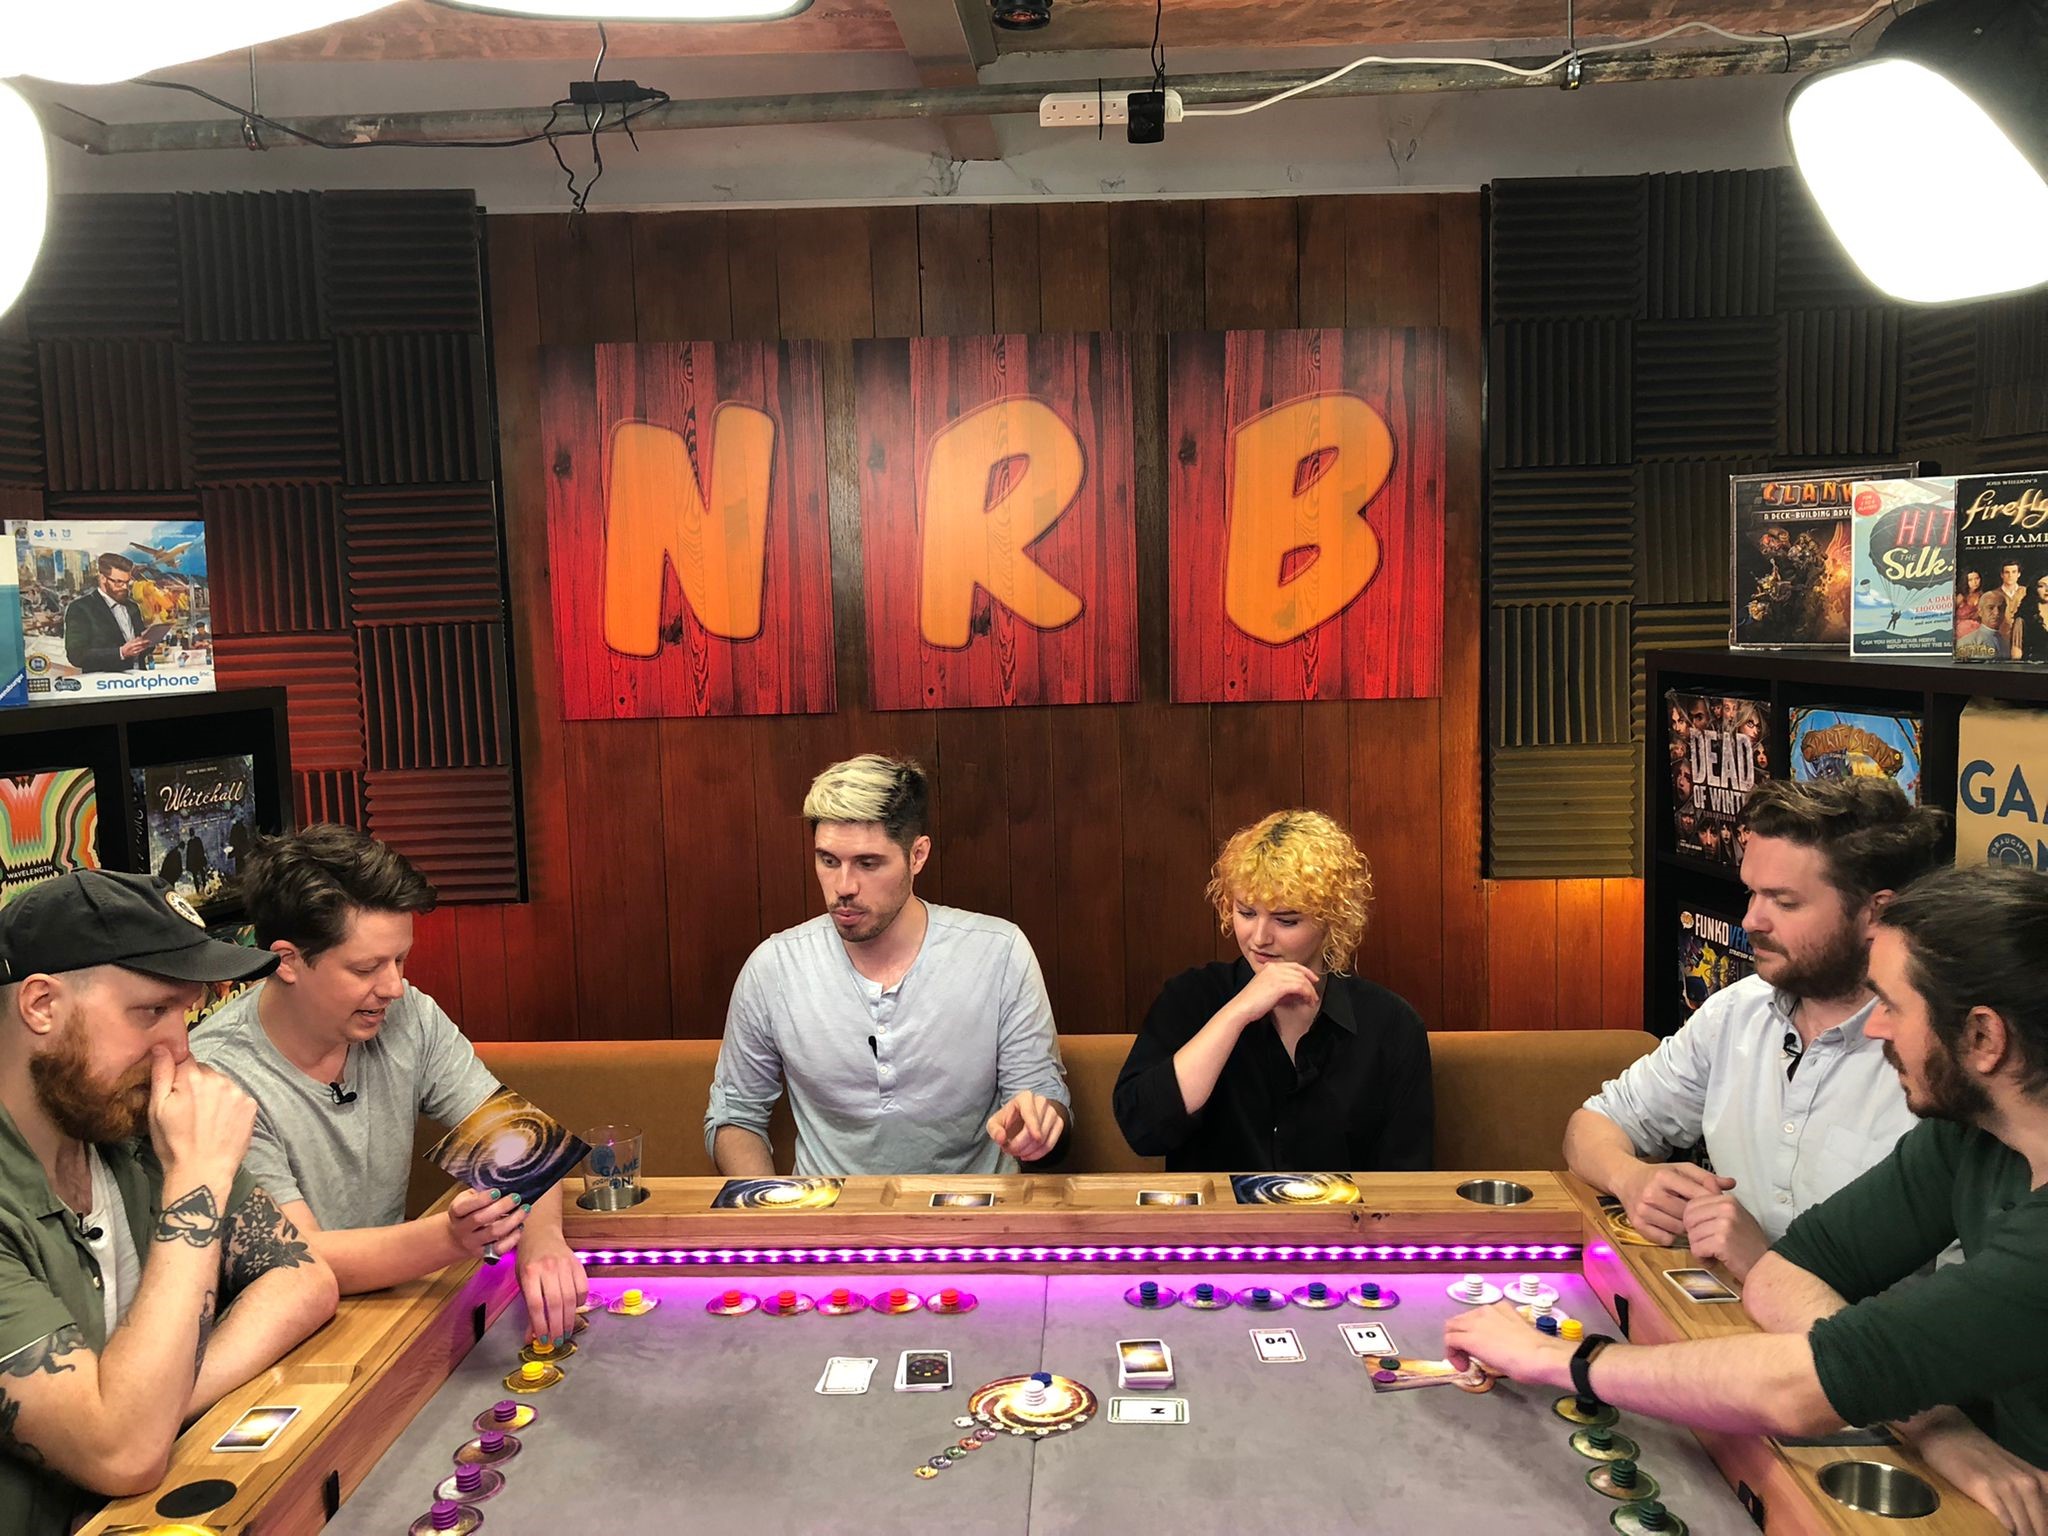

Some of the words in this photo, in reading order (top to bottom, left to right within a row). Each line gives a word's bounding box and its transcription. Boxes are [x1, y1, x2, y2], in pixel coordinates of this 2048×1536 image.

[1895, 510, 1955, 546] HIT
[1963, 534, 1997, 545] THE
[96, 674, 200, 690] smartphone
[1689, 727, 1755, 793] DEAD
[160, 781, 243, 812] Whitehall
[1693, 785, 1706, 809] OF
[1709, 787, 1745, 815] WINT
[1960, 759, 2048, 825] GA
[6, 865, 53, 879] WAVELENGTH
